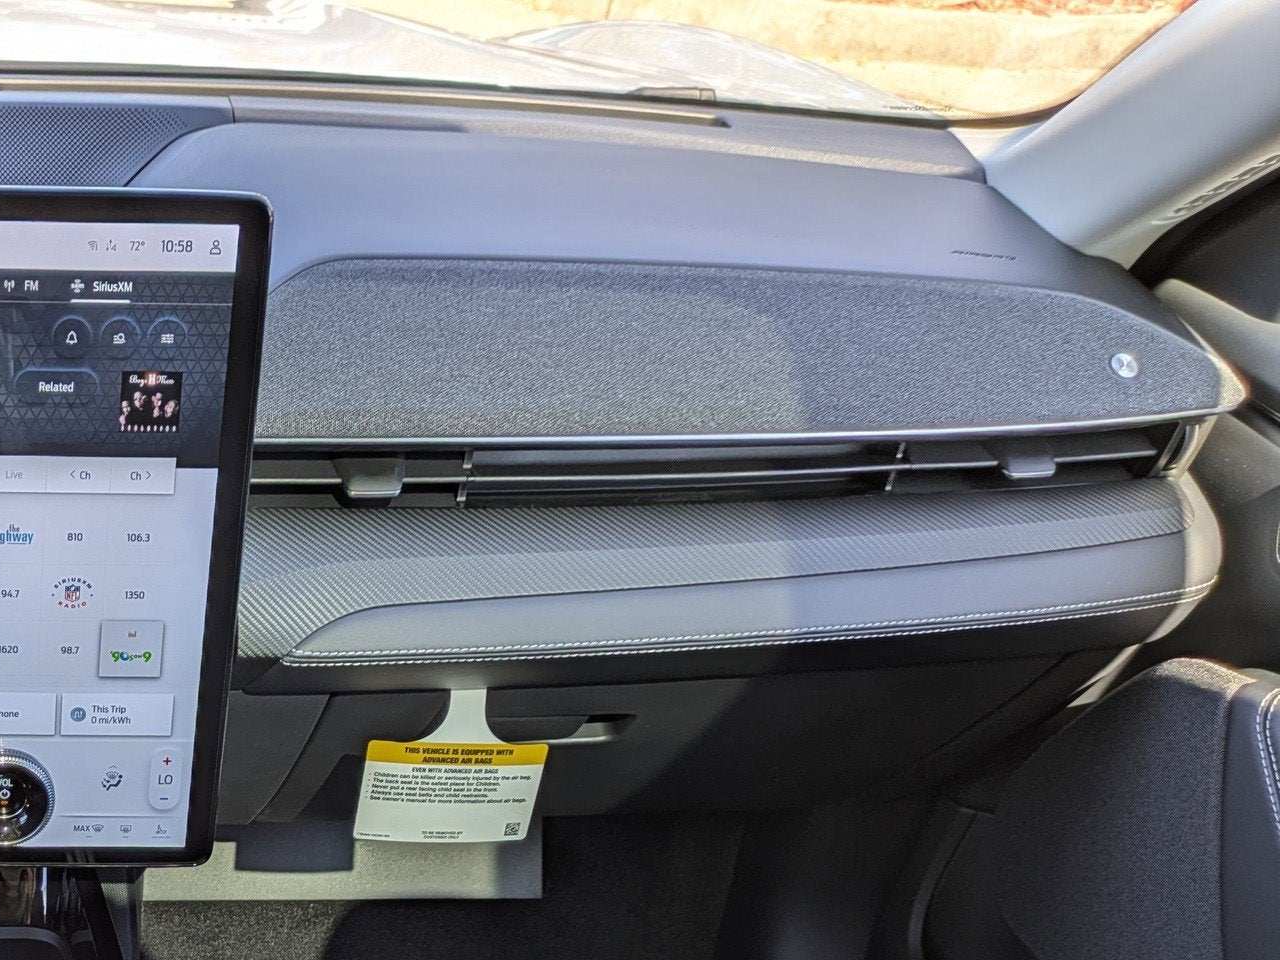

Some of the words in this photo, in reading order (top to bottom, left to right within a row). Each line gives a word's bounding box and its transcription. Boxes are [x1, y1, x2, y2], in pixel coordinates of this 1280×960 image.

[161, 239, 193, 253] 10:58
[24, 280, 39, 291] FM
[93, 281, 133, 292] SiriusXM
[39, 382, 74, 393] Related
[5, 470, 24, 479] Live
[79, 470, 91, 480] Ch
[130, 471, 142, 481] Ch
[9, 524, 20, 533] the
[67, 532, 83, 542] 810
[126, 532, 151, 542] 106.3
[0, 589, 20, 599] 94.7
[125, 590, 145, 600] 1350
[57, 601, 87, 609] RADIO
[60, 645, 80, 655] 98.7
[91, 704, 109, 714] This
[110, 705, 127, 715] Trip
[91, 716, 97, 724] 0
[98, 716, 131, 725] mi/kWh
[158, 774, 173, 785] LO
[73, 824, 91, 832] MAX
